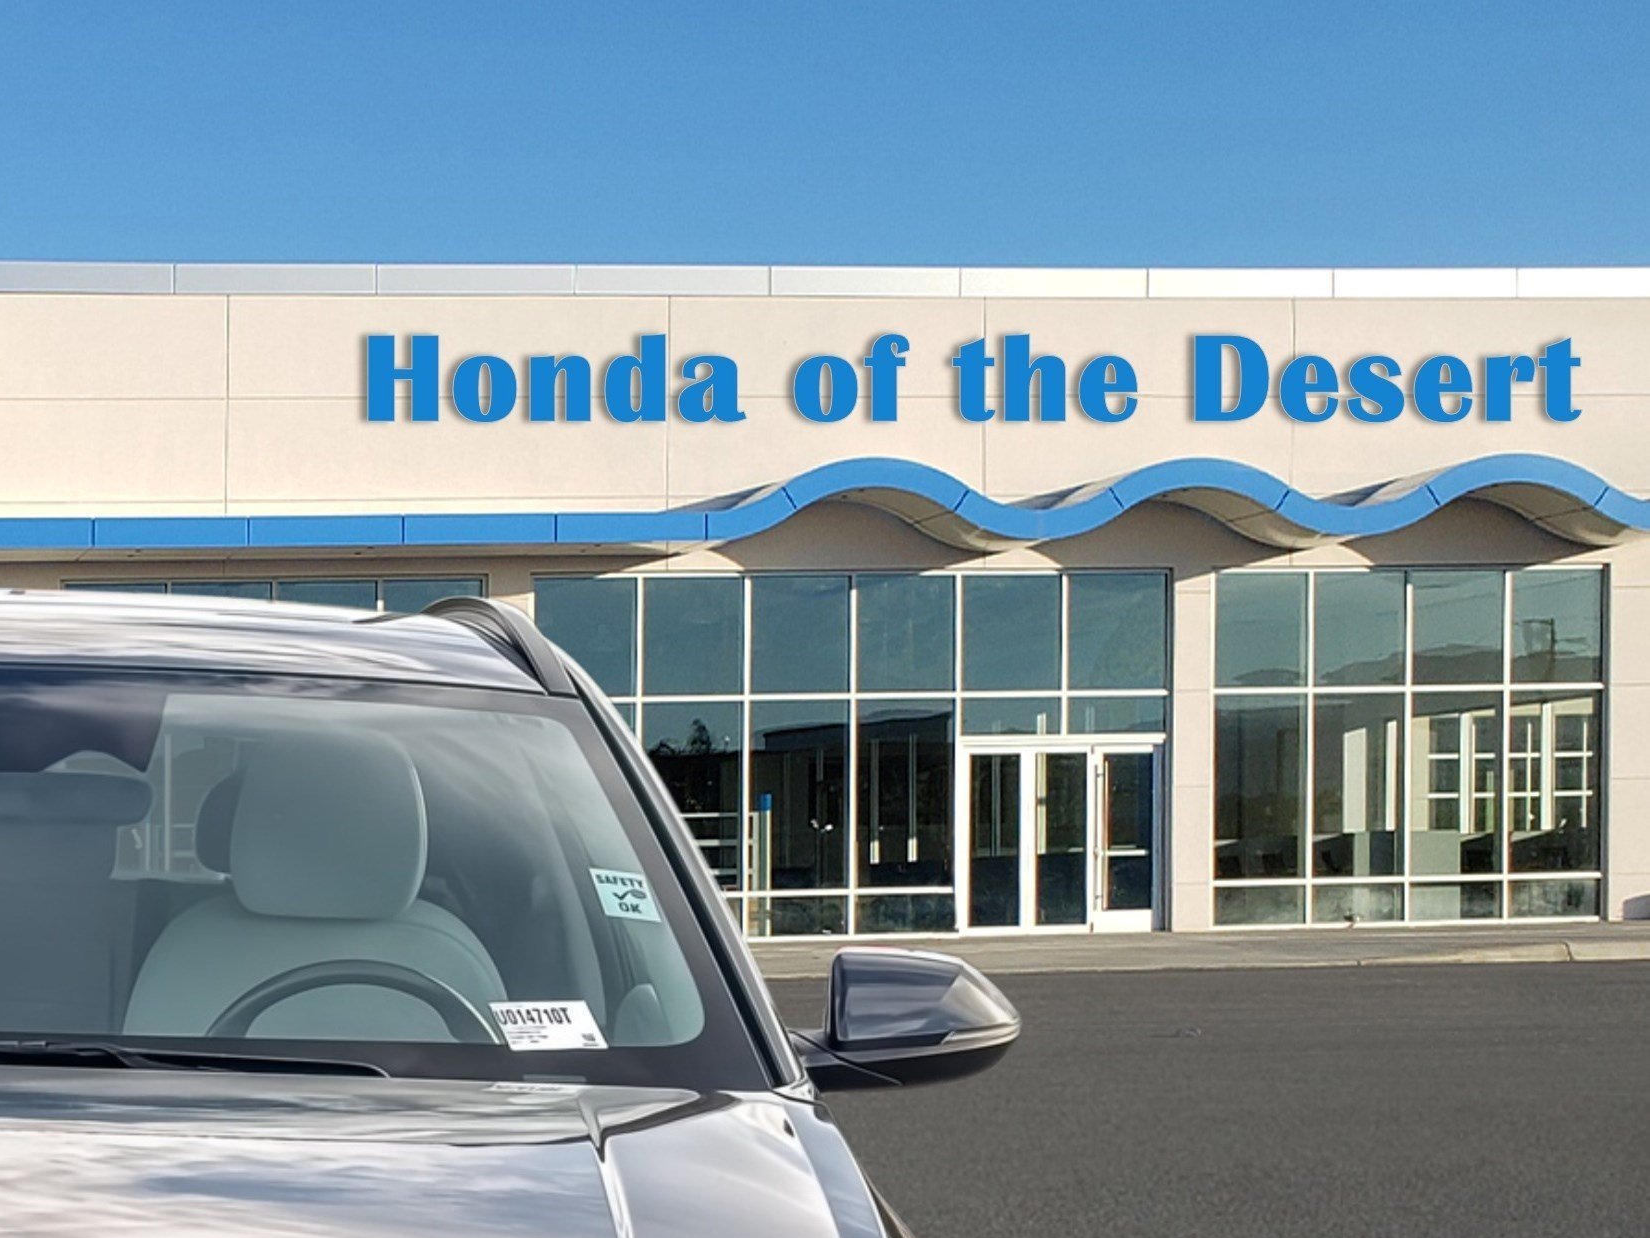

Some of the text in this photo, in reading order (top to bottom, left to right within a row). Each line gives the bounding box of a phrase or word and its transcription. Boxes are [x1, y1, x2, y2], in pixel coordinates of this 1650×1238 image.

[364, 332, 1583, 424] Honda of the Desert
[595, 873, 644, 889] SAFETY
[618, 901, 643, 914] OK
